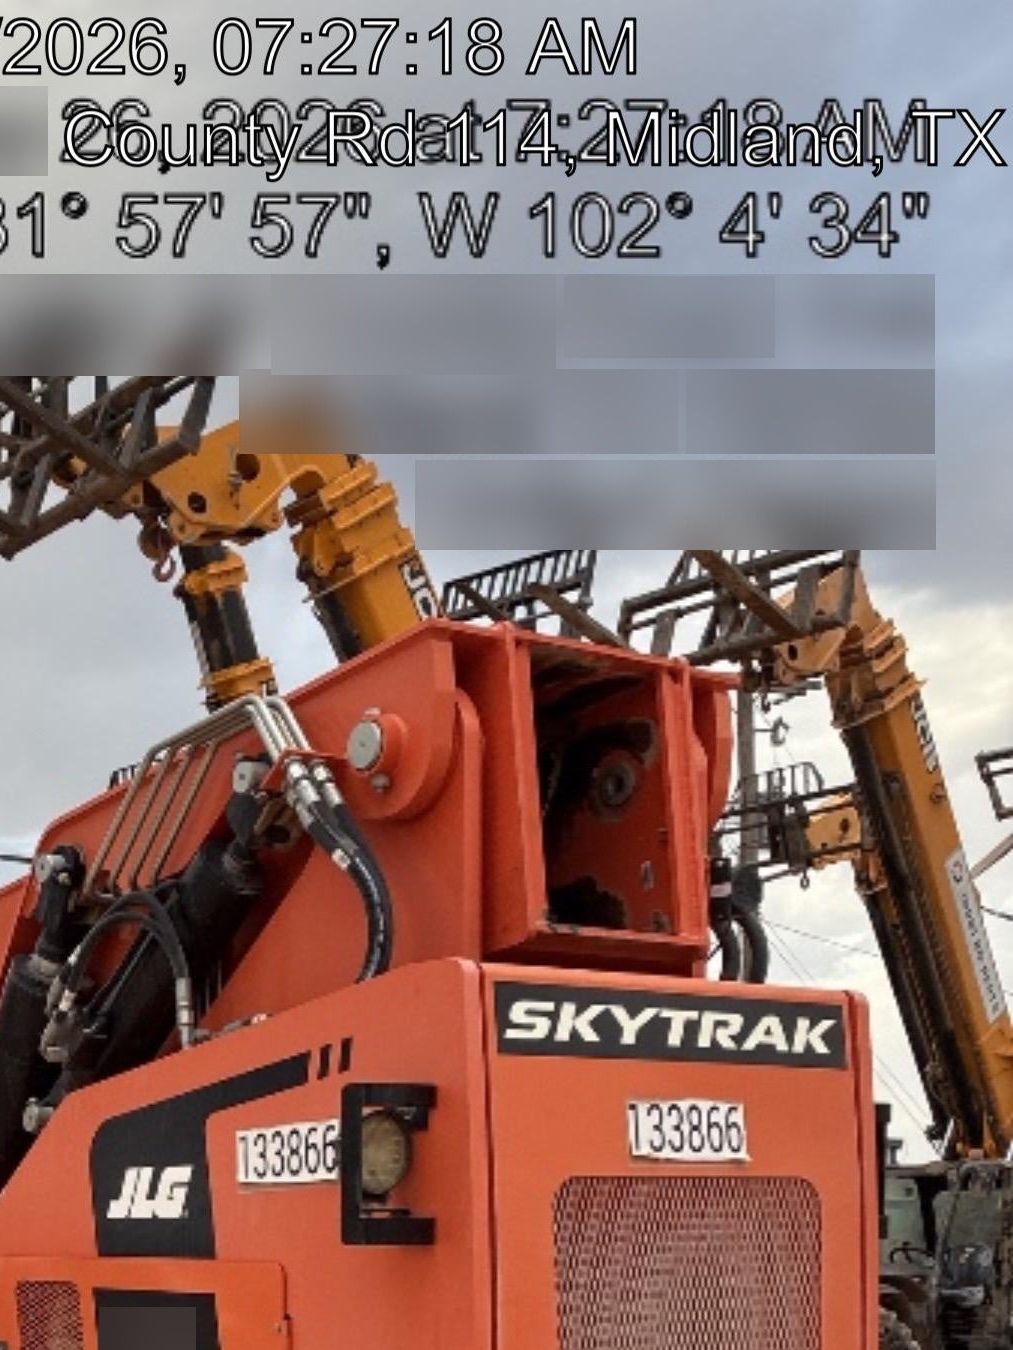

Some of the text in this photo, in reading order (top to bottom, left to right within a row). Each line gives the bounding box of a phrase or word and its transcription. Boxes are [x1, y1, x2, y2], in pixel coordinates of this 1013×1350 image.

[503, 1000, 836, 1054] SKYTRAK
[238, 1124, 338, 1179] 133866
[627, 1102, 743, 1153] 133866
[106, 1165, 195, 1219] JLG
